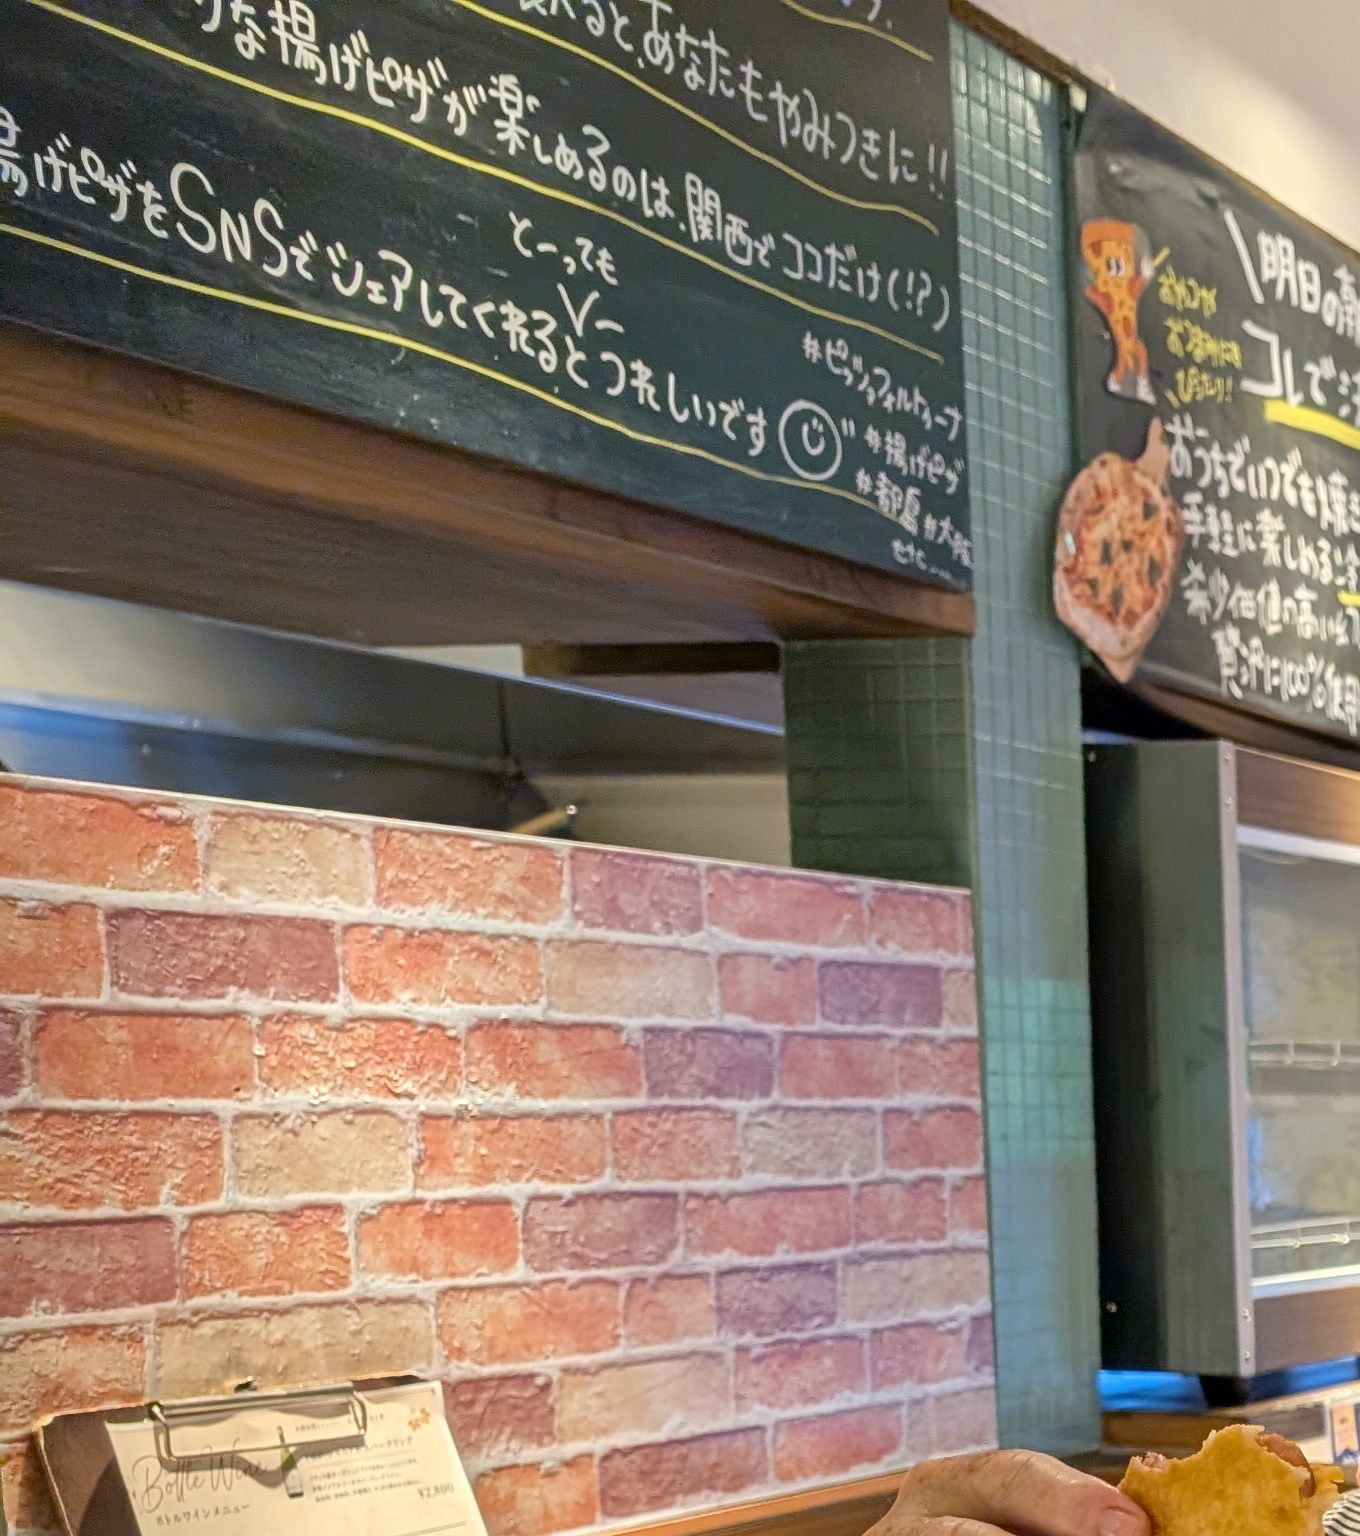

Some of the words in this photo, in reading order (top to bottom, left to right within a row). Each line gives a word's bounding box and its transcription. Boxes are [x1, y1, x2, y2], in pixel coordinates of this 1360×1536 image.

[520, 0, 948, 199] ると、あなたもやみつきに!!
[132, 1454, 206, 1514] Bottle
[156, 1503, 251, 1527] ボトルワインメニュー
